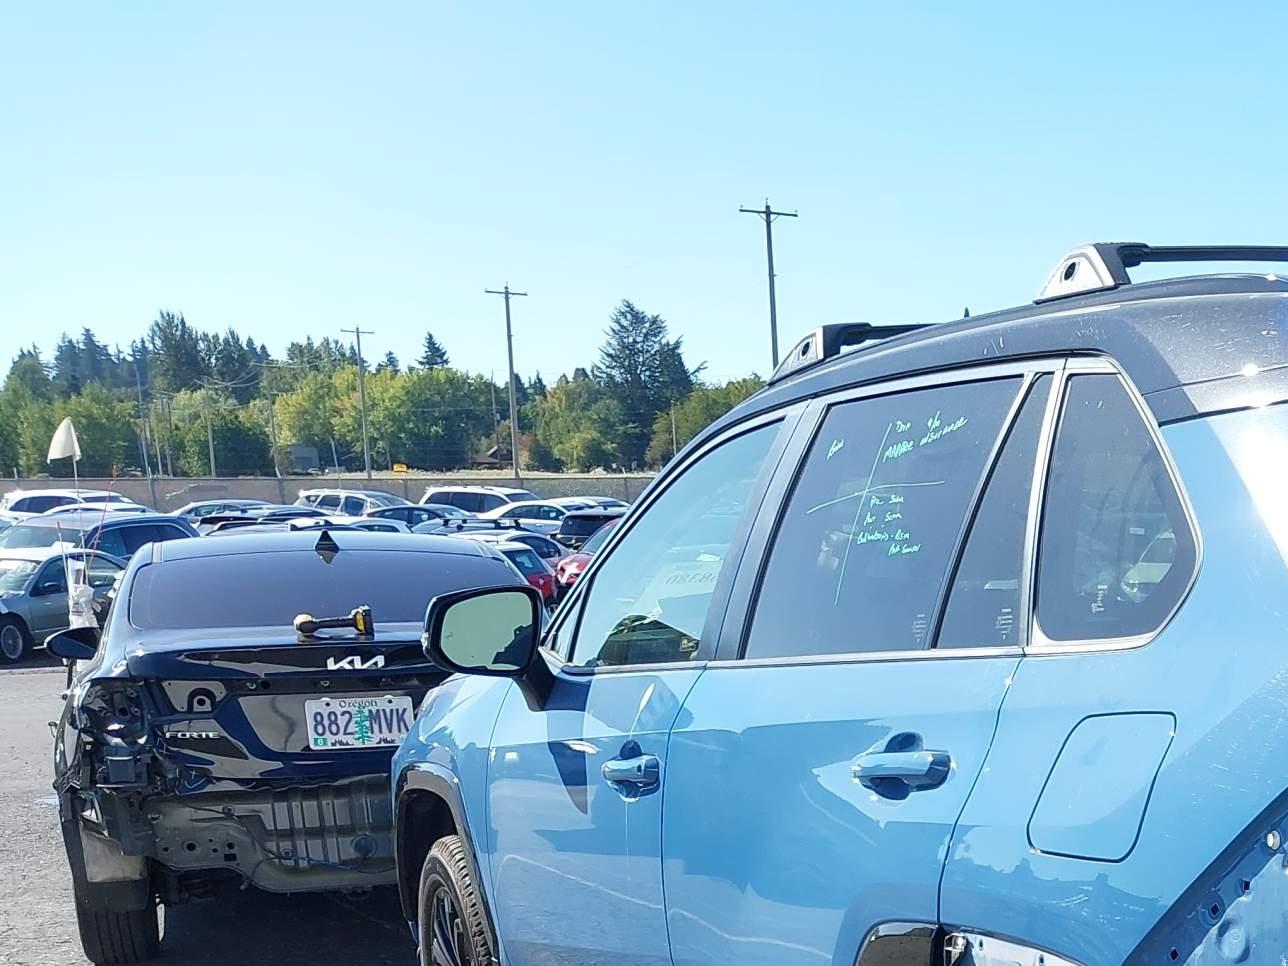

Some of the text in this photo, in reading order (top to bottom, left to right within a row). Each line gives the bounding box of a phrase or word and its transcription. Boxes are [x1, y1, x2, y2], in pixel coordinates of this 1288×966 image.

[327, 655, 385, 670] KIA
[338, 700, 378, 710] Oregon
[313, 708, 410, 737] 882 MVK
[165, 731, 221, 739] FORTE
